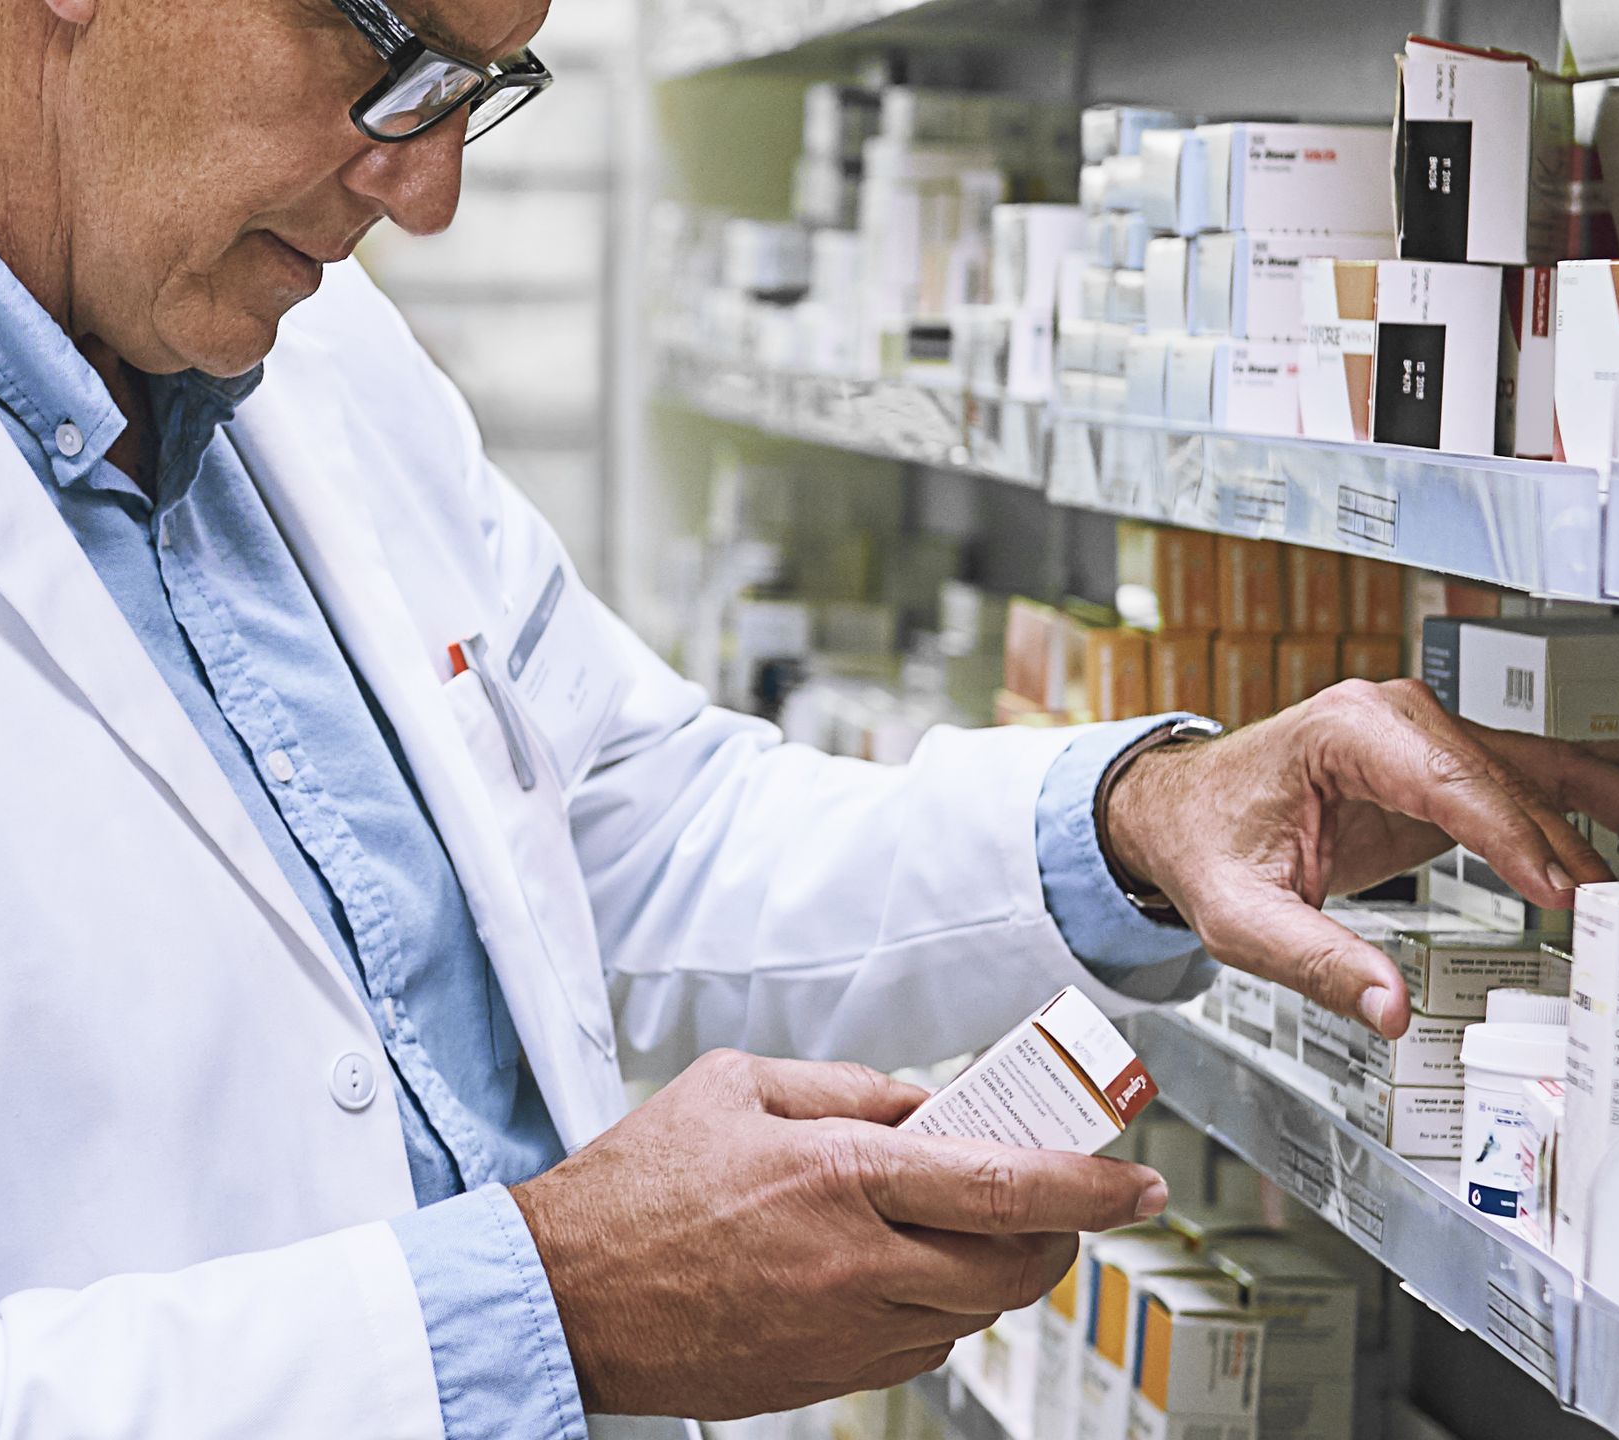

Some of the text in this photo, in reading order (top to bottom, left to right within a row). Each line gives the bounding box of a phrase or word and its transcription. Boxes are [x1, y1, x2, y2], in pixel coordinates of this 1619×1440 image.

[986, 1066, 1016, 1100] DOSIS EN
[1022, 1038, 1039, 1058] ELKE
[1073, 1101, 1097, 1129] TABLET
[926, 1113, 943, 1132] HOU
[956, 1089, 992, 1131] BERG BY OF
